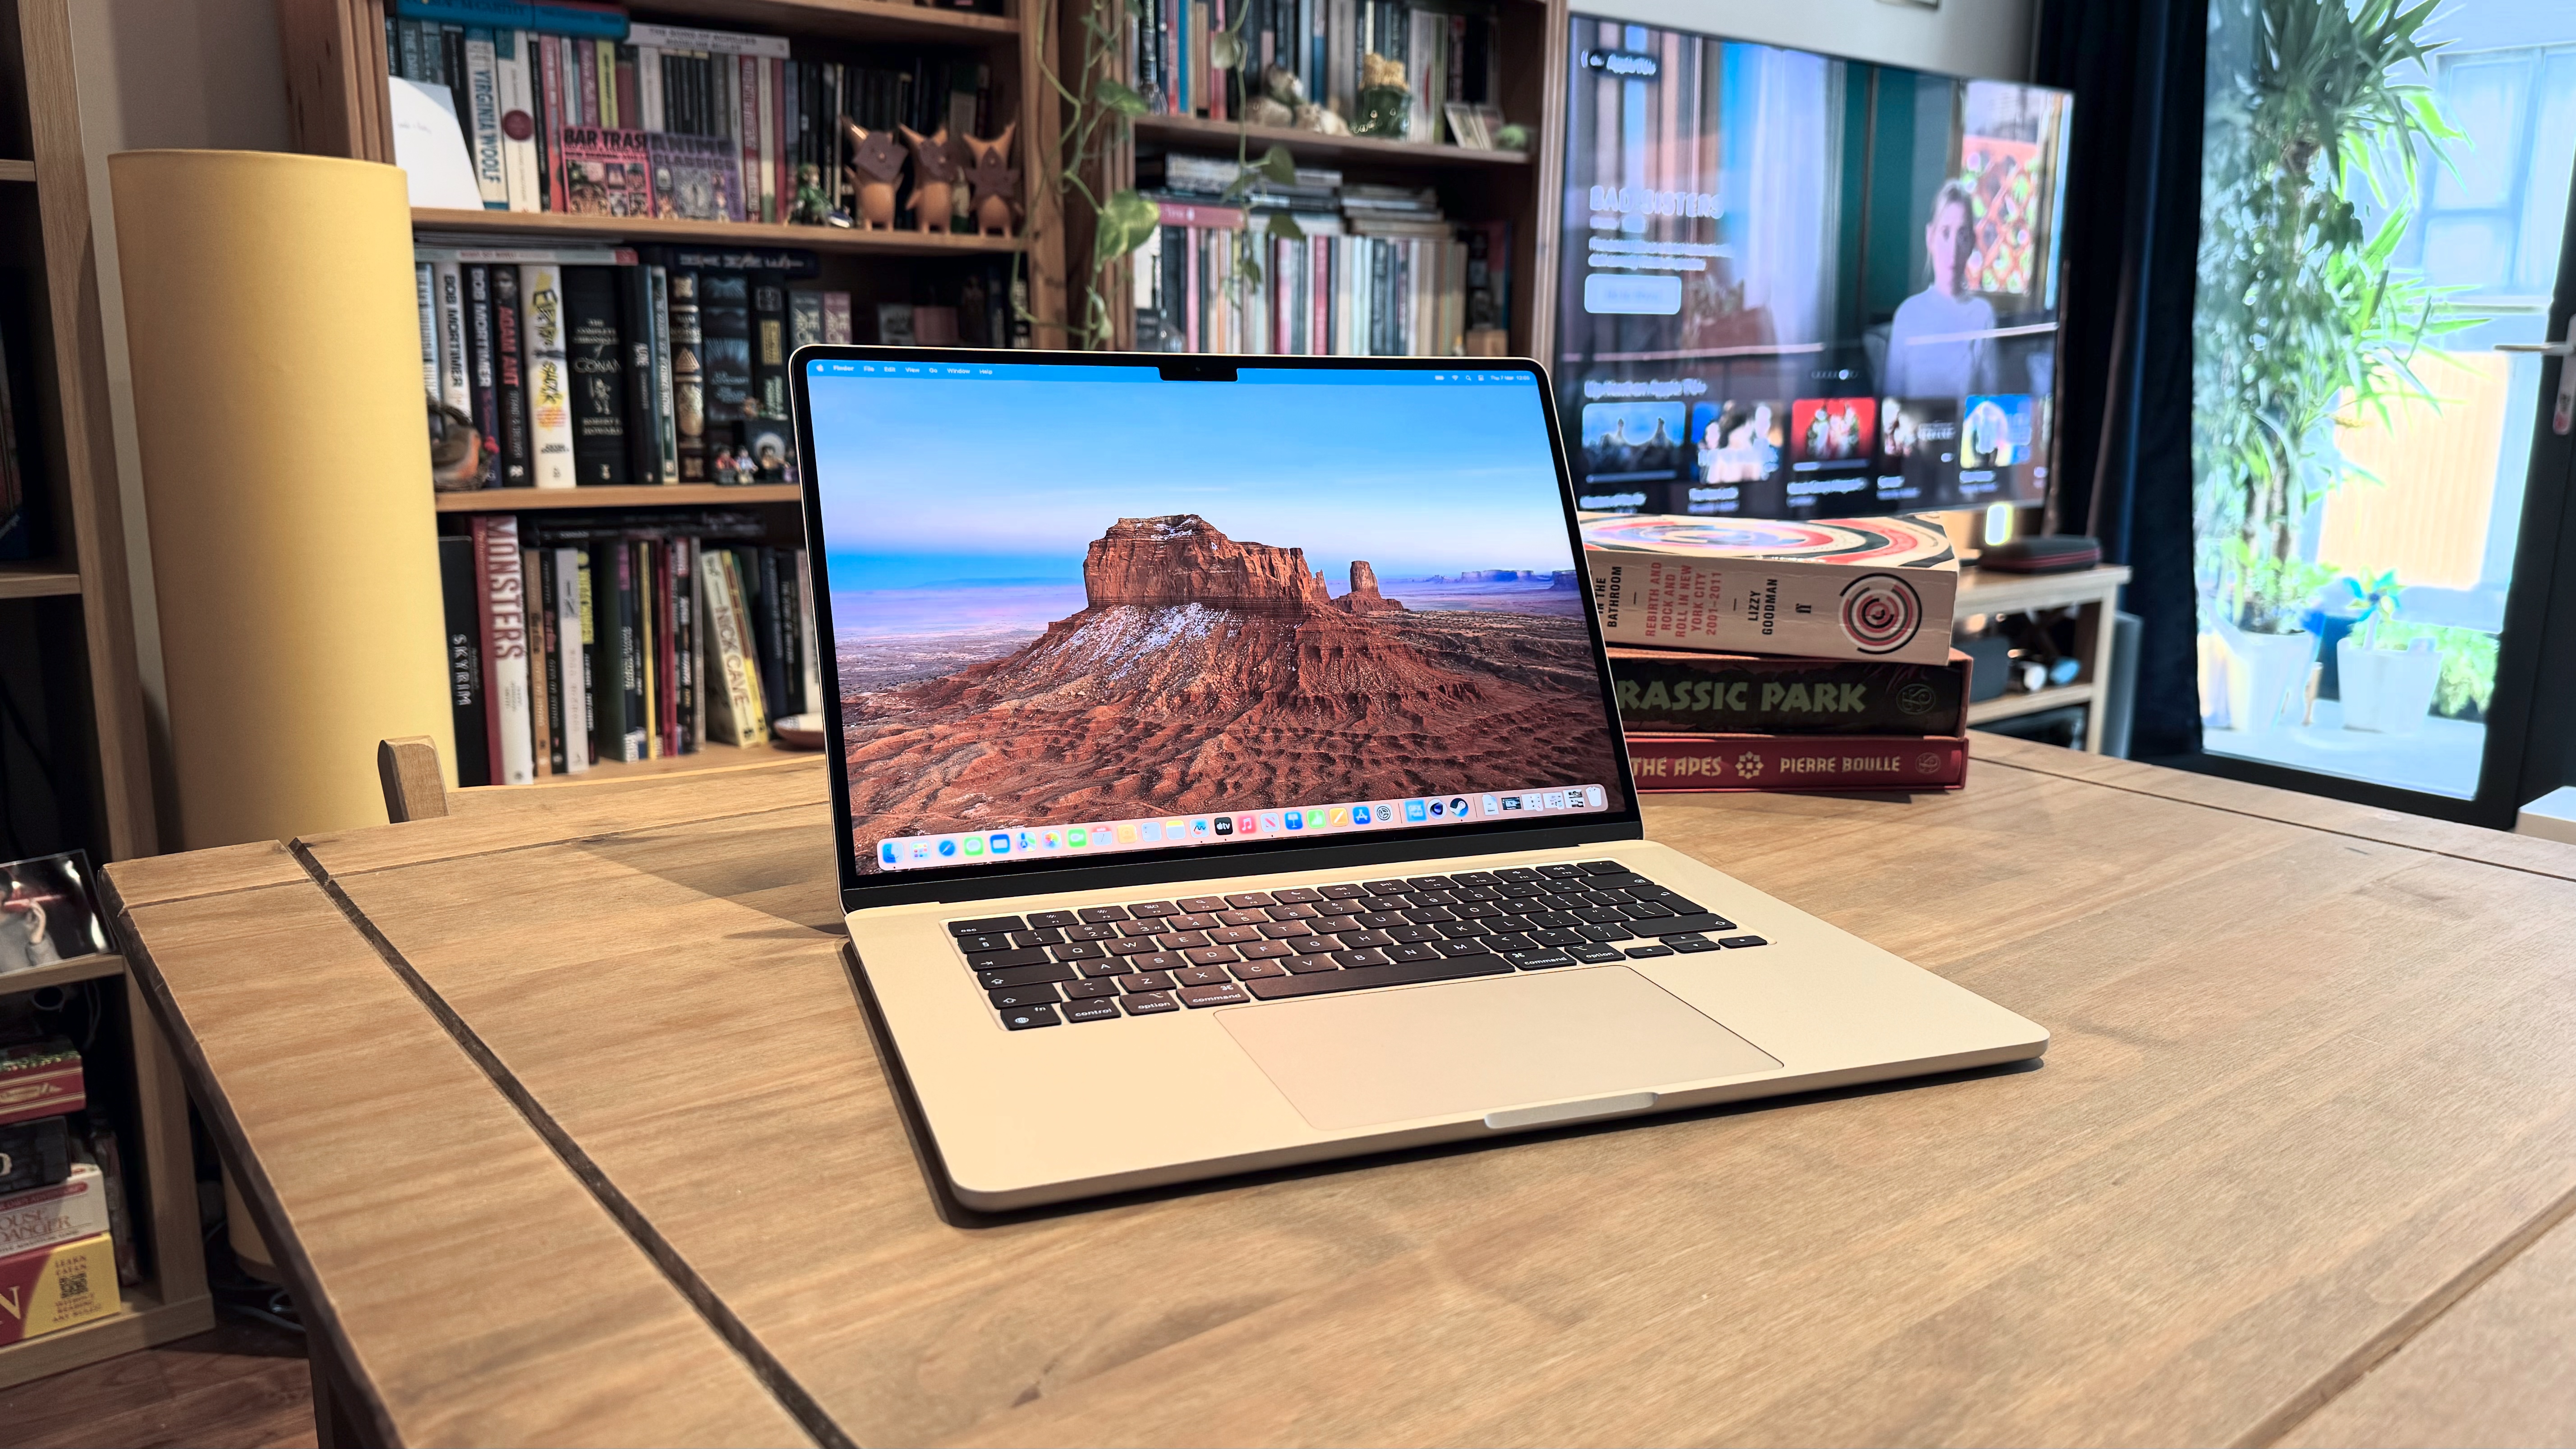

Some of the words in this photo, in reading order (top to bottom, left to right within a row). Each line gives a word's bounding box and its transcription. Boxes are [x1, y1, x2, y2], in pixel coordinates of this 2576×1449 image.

[474, 70, 496, 130] VIRGINIA
[564, 129, 597, 147] BAR
[480, 134, 501, 184] WOOLF
[1590, 185, 1633, 213] BAD
[1640, 189, 1725, 219] SISTERS
[444, 275, 457, 305] BOB
[471, 268, 486, 301] BOB
[498, 306, 516, 353] ADAM
[446, 309, 464, 388] MORTIMER
[474, 304, 492, 388] MORTIMER
[501, 355, 519, 387] ANT
[574, 356, 622, 373] CONAN
[1595, 577, 1606, 599] THE
[1651, 562, 1662, 584] AND
[1665, 574, 1676, 597] AND
[1680, 565, 1692, 590] NEW
[1694, 573, 1707, 598] CITY
[487, 518, 525, 661] MONSTERS
[1607, 566, 1622, 628] BATHROOM
[1678, 594, 1689, 606] IN
[1645, 589, 1660, 637] REBIRTH
[1661, 600, 1673, 630] ROCK
[1691, 603, 1703, 631] YORK
[1748, 591, 1761, 621] LIZZY
[1762, 579, 1778, 635] GOODMAN
[1675, 610, 1688, 638] ROLL
[452, 634, 473, 706] SKYRIM
[714, 606, 737, 653] NICK
[726, 655, 750, 707] CAVE
[1617, 679, 1749, 711] RASSIC
[1760, 681, 1867, 713] PARK
[1630, 756, 1667, 777] THE
[1674, 756, 1722, 777] APES
[1780, 756, 1836, 773] PIERRE
[1842, 755, 1902, 773] BOULLE
[1523, 956, 1568, 965] command
[1586, 951, 1615, 959] option
[1075, 1008, 1112, 1017] control
[1137, 1000, 1171, 1010] option
[1192, 993, 1242, 1003] command
[55, 1265, 87, 1276] CATAN
